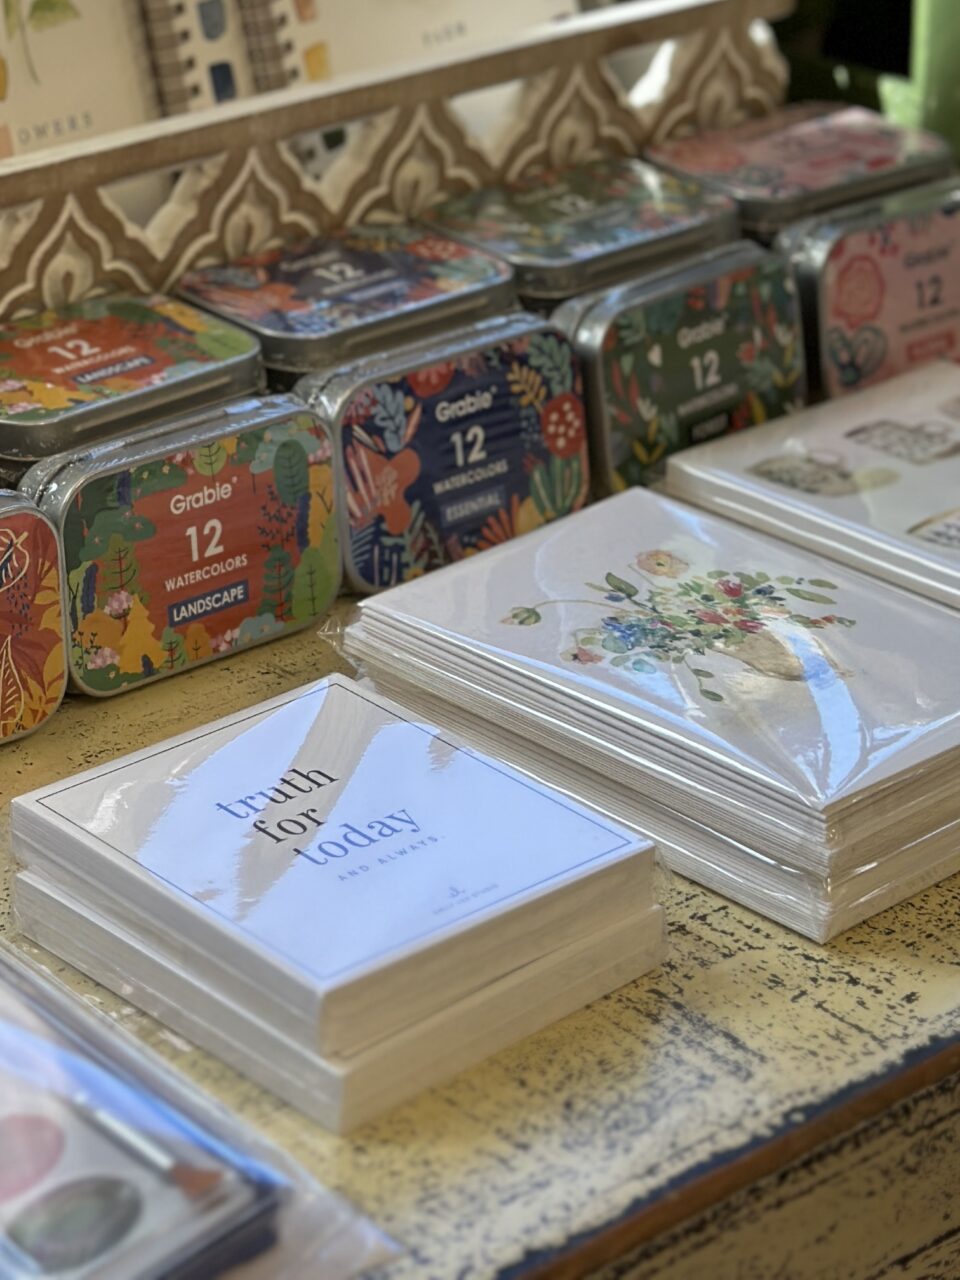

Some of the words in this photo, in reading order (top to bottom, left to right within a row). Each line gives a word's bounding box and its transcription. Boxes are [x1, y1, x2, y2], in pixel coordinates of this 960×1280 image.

[915, 274, 943, 310] 12
[47, 339, 102, 360] 12
[690, 350, 722, 391] 12
[435, 389, 493, 422] Grabie
[450, 425, 487, 467] 12
[432, 459, 509, 495] WATERCOLORS
[170, 482, 233, 515] Grabie
[445, 492, 501, 522] ESSENTIAL
[185, 519, 225, 562] 12
[165, 553, 249, 593] WATERCOLORS
[173, 585, 245, 623] LANDSCAPE
[215, 767, 340, 821] truth
[252, 807, 327, 844] for
[292, 808, 422, 866] today
[338, 864, 370, 882] AND
